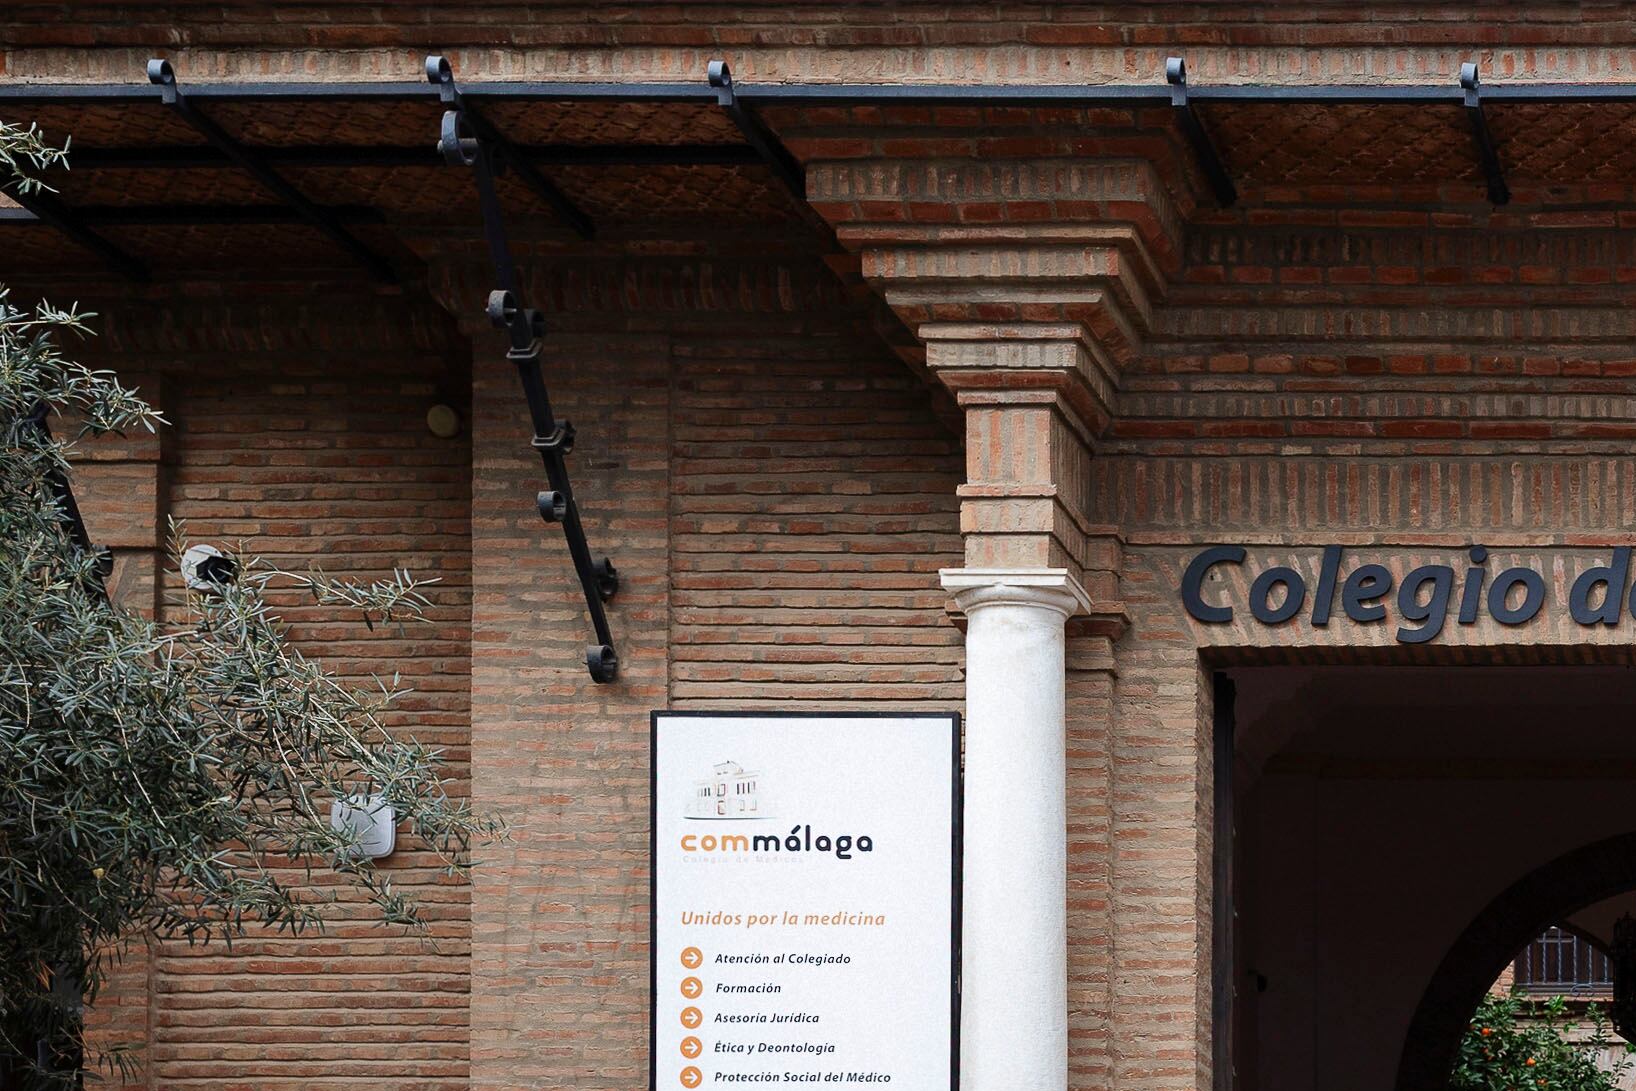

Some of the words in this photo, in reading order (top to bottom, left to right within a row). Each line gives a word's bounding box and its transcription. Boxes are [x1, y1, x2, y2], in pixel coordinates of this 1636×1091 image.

[1181, 546, 1546, 643] Colegio
[681, 825, 873, 859] commálaga
[682, 911, 742, 925] Unidos
[747, 915, 778, 929] por
[782, 911, 799, 925] la
[804, 911, 885, 926] medicina
[715, 953, 769, 964] Atención
[773, 953, 785, 964] al
[788, 953, 851, 967] Colegiado
[716, 982, 781, 993] Formación
[714, 1040, 744, 1053] Ética
[746, 1045, 755, 1055] y
[714, 1072, 780, 1082] Protección
[783, 1072, 821, 1082] Social
[824, 1072, 844, 1082] del
[846, 1072, 891, 1082] Médico
